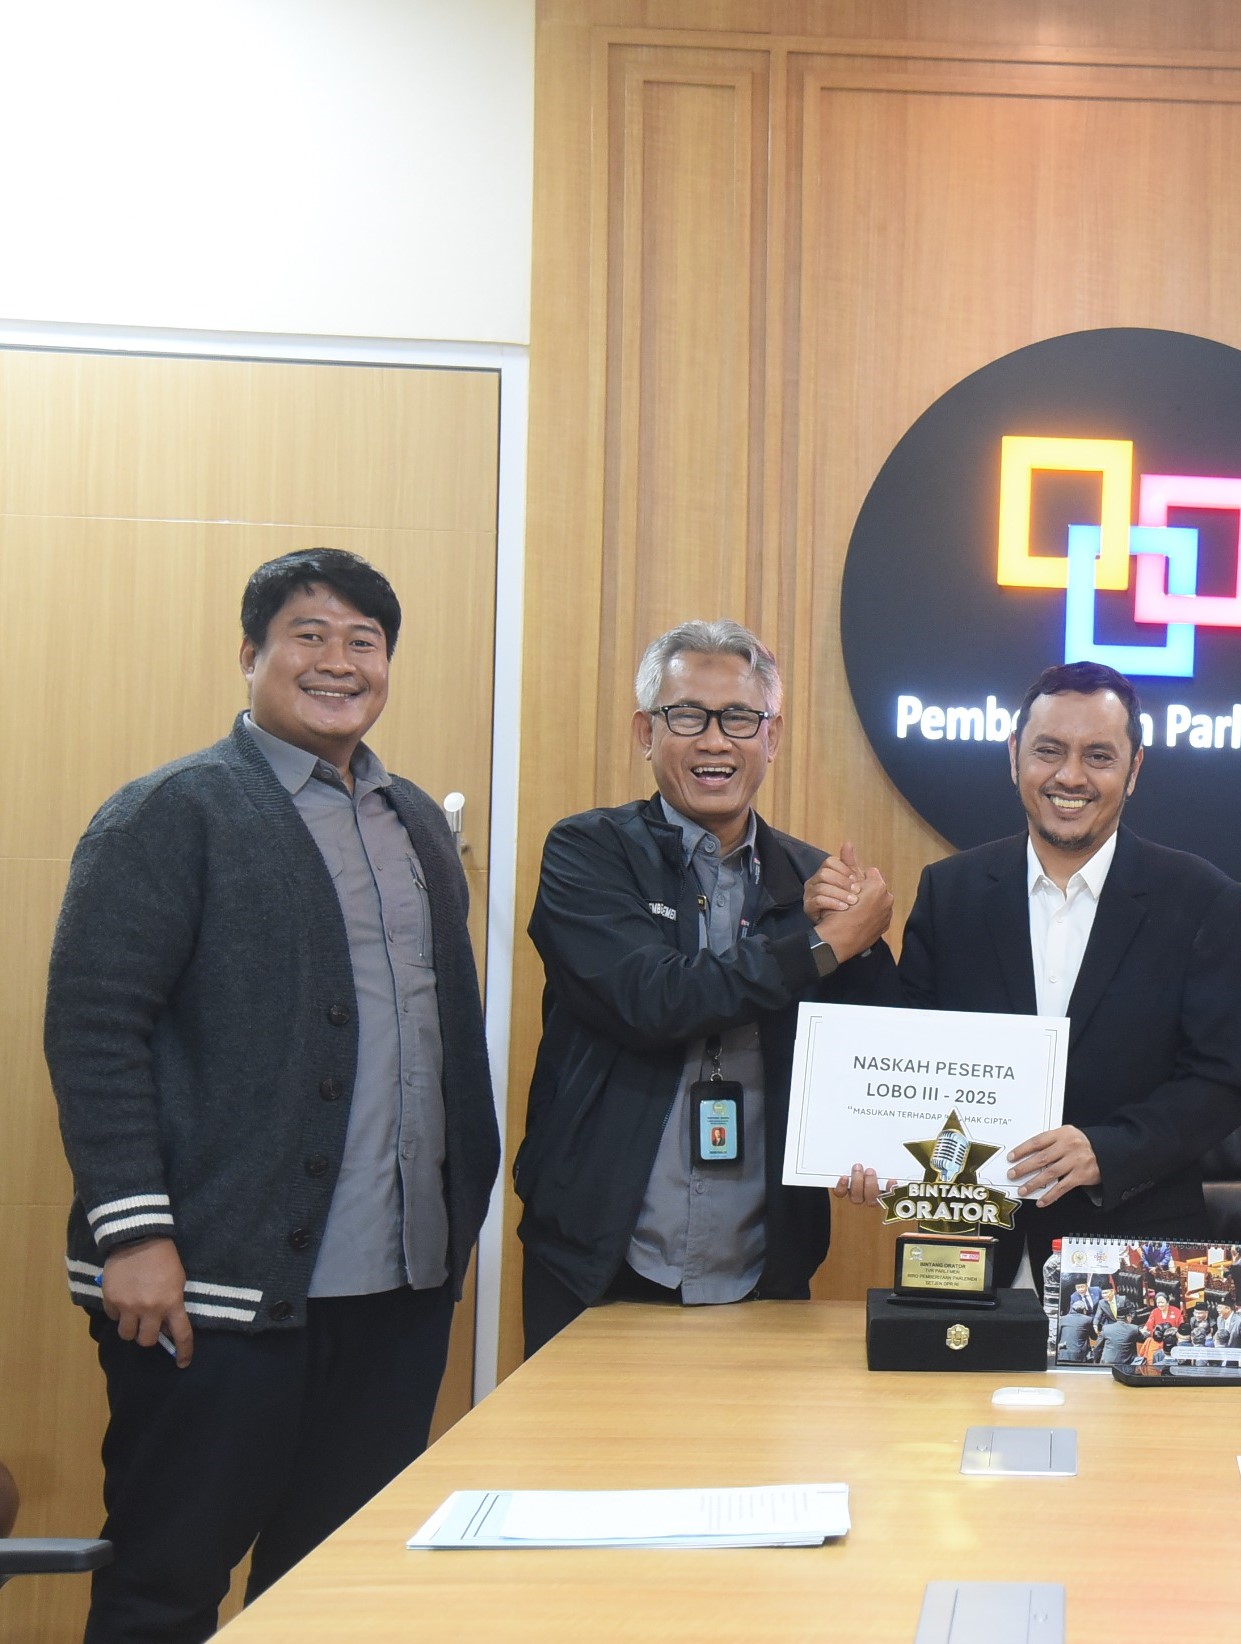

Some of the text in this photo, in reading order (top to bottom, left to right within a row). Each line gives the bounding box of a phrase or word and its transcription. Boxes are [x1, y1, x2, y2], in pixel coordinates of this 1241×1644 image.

[853, 1055, 1015, 1080] NASKAH PESERTA
[866, 1082, 917, 1099] LOBO
[922, 1086, 939, 1101] III
[954, 1089, 997, 1105] 2025
[898, 1110, 942, 1121] TERHADAP
[964, 1115, 982, 1124] HAK
[908, 1183, 988, 1201] BINTANG
[895, 1199, 999, 1223] ORATOR
